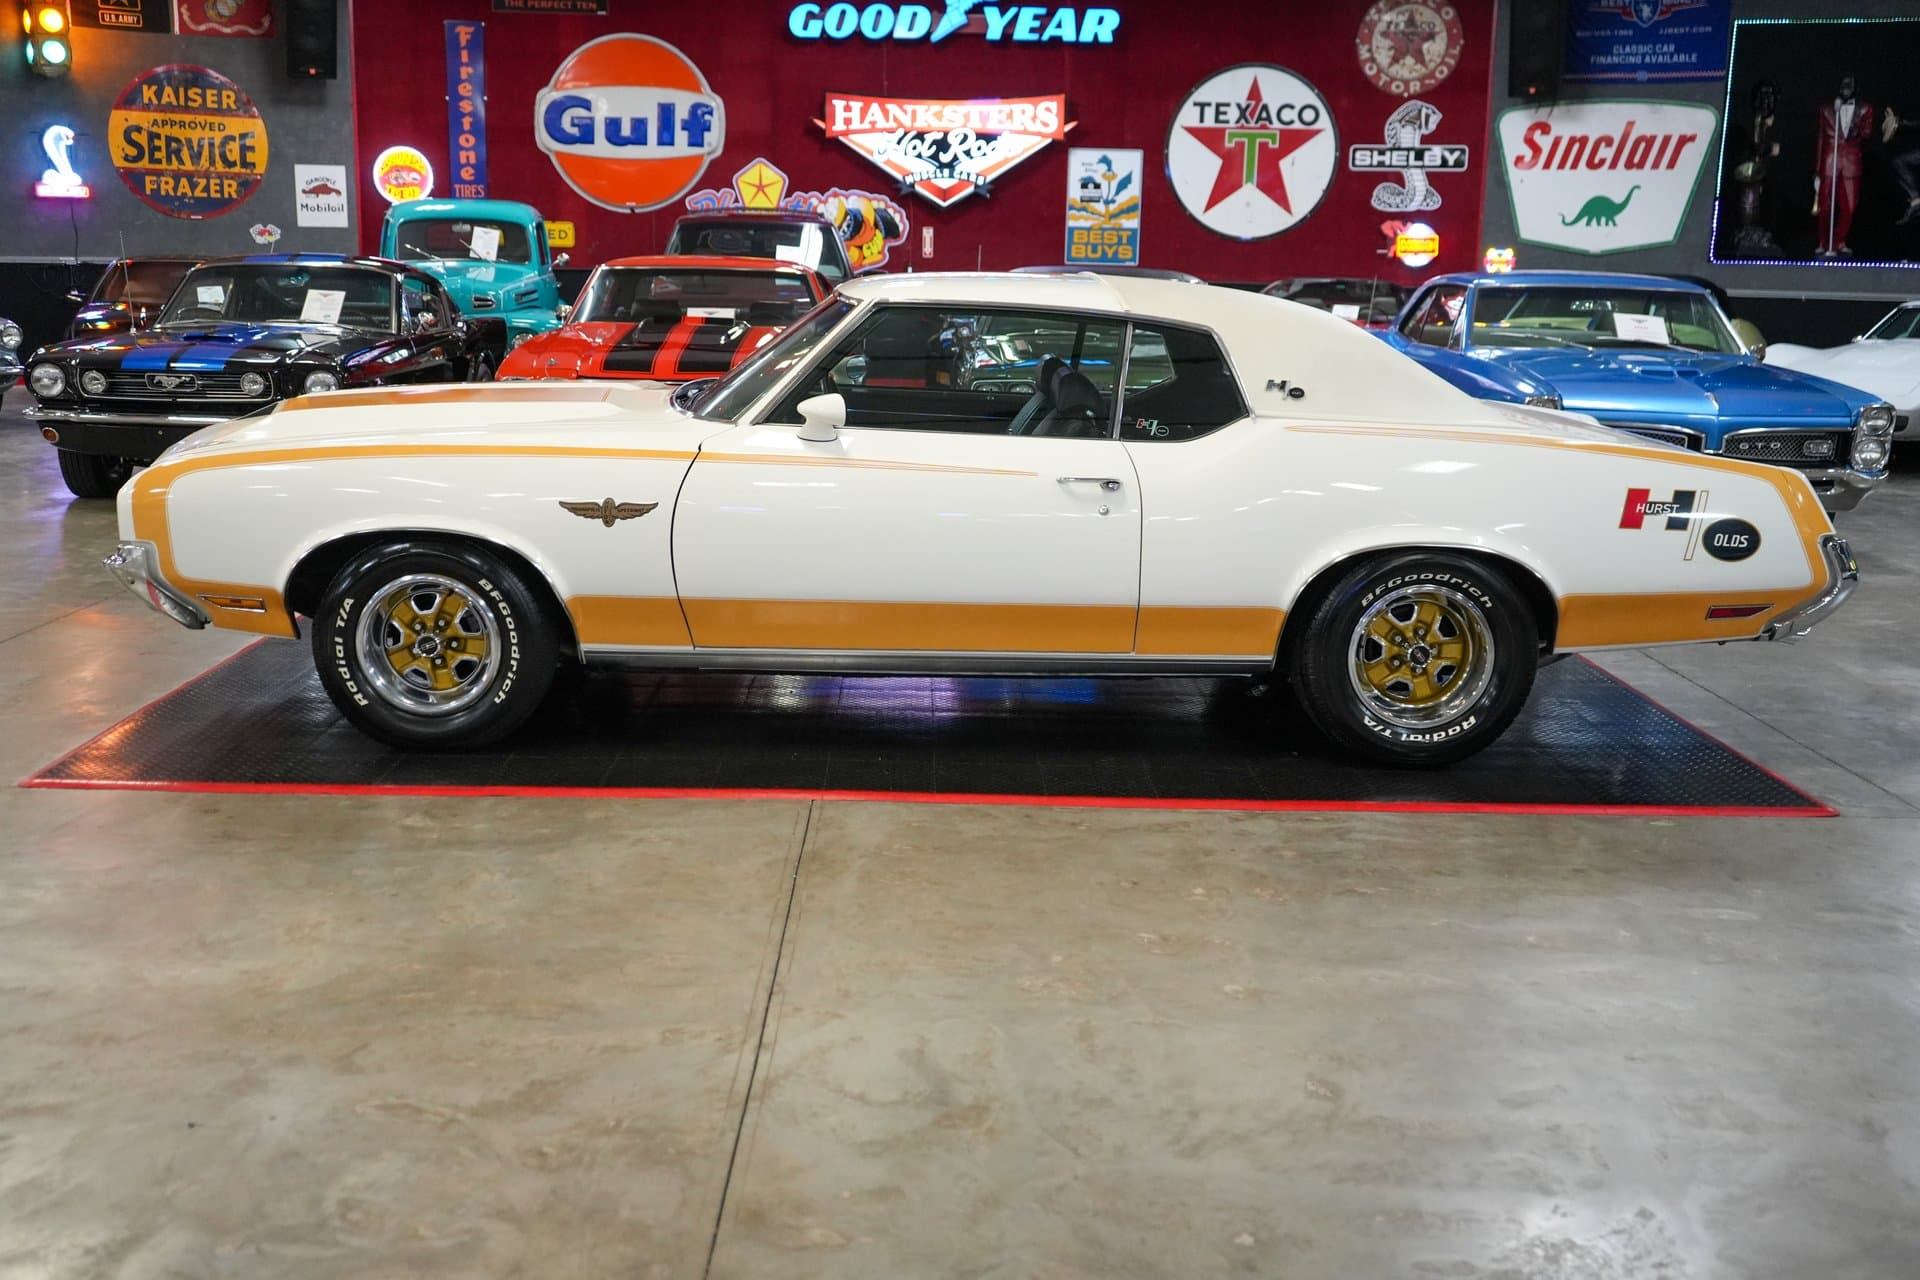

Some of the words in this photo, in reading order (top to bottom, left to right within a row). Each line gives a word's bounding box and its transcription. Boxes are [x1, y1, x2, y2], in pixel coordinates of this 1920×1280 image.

[504, 0, 525, 8] THE
[527, 0, 572, 9] PERFECT
[576, 2, 597, 10] TEN
[118, 15, 138, 25] ARMY
[1613, 44, 1653, 55] CLASSIC
[1655, 43, 1676, 53] CAR
[1590, 54, 1643, 65] FINANCING
[1645, 53, 1698, 64] AVAILABLE
[142, 84, 238, 110] KAISER
[453, 24, 478, 182] Firestone
[543, 94, 714, 147] Gulf
[831, 98, 1060, 133] HANKSTERS
[1193, 101, 1320, 127] TEXACO
[151, 118, 227, 132] APPROVED
[123, 124, 257, 170] SERVICE
[1514, 120, 1697, 171] Sinclair
[1353, 150, 1461, 167] SHELBY
[905, 167, 949, 185] MUSCLE
[953, 168, 986, 186] CARS
[145, 175, 239, 200] FRAZER
[454, 184, 485, 198] TIRES
[300, 203, 344, 213] Mobiloil
[1073, 229, 1132, 244] BEST
[1071, 243, 1133, 259] BUYS
[1635, 502, 1681, 515] HURST
[1713, 533, 1749, 548] OLDS
[1361, 572, 1493, 609] BFGoodrich
[336, 597, 355, 629] T/A
[478, 578, 521, 705] BFGoodrich
[334, 636, 370, 707] Radial
